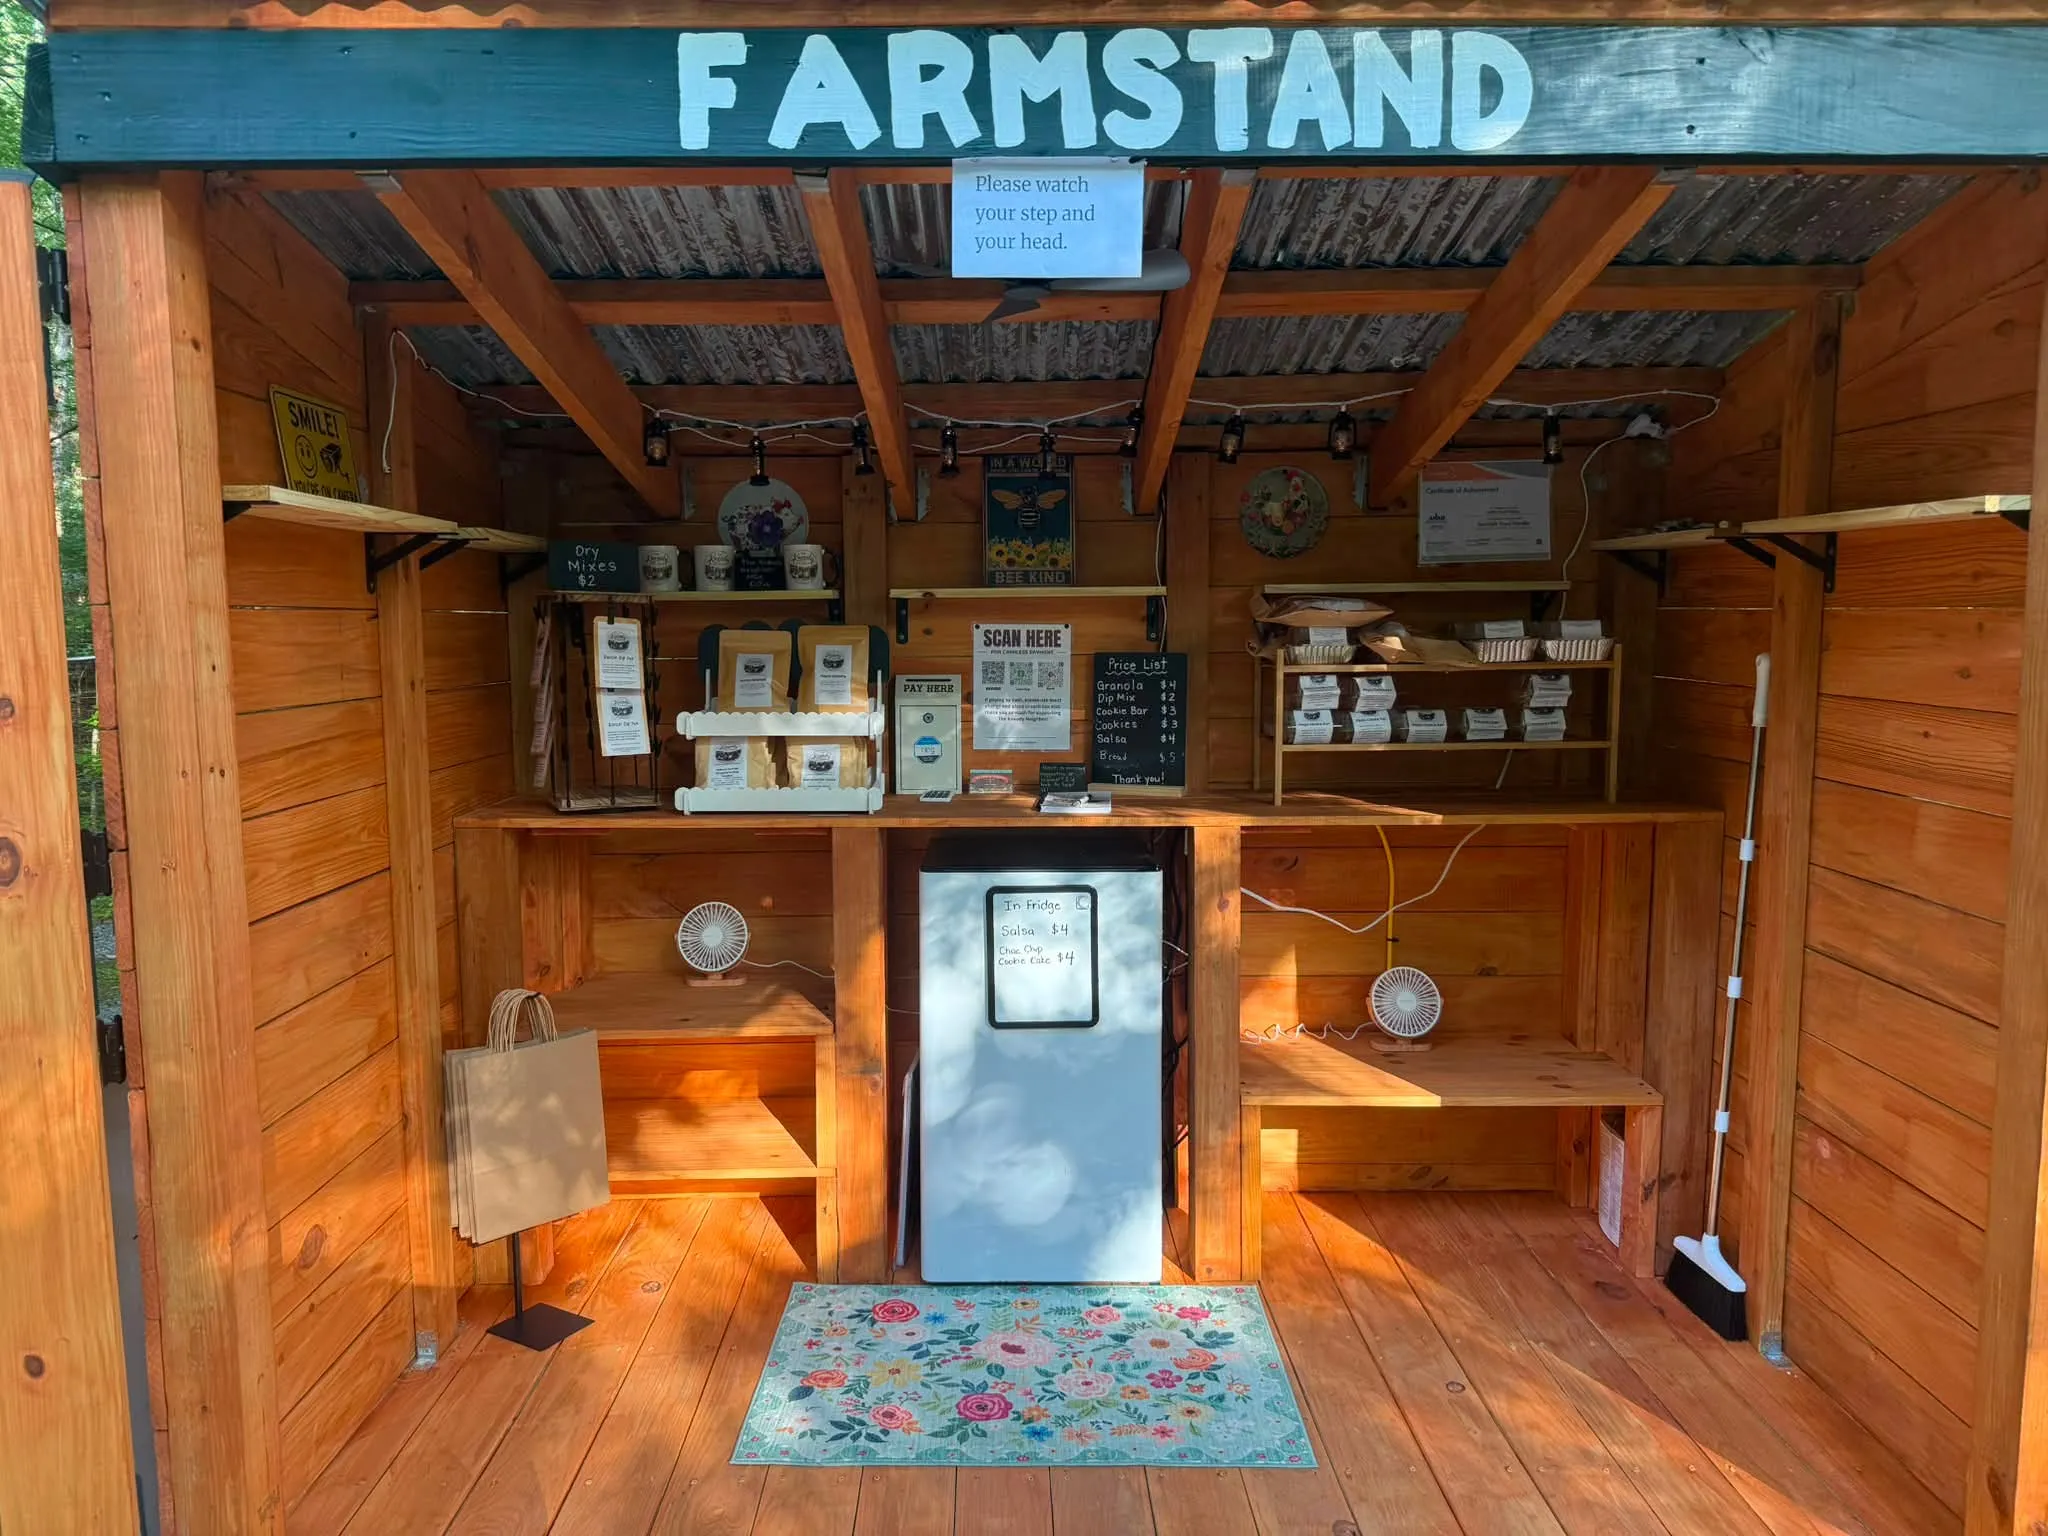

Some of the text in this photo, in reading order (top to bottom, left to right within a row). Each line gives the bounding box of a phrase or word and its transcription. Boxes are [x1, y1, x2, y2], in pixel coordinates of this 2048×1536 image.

[678, 27, 1534, 151] FARMSTAND
[976, 175, 1089, 192] Please watch
[976, 204, 1095, 225] your step and
[976, 232, 1068, 253] your head.
[288, 400, 340, 439] SMILE!
[575, 545, 600, 560] Dry
[568, 560, 617, 573] Mixes
[578, 574, 598, 588] $2
[995, 571, 1066, 584] BEE KIND
[984, 629, 1061, 647] SCAN HERE
[1108, 656, 1168, 671] Price List
[903, 684, 954, 693] PAY HERE
[1097, 679, 1177, 691] Granola $4
[1097, 692, 1176, 706] Dip Mix $2
[1096, 706, 1127, 716] Cookie
[1130, 706, 1149, 716] Bar
[1095, 717, 1138, 731] Cookies
[1096, 733, 1176, 745] Salsa $4
[1099, 750, 1128, 761] Bread
[1112, 770, 1165, 786] Thank you!
[1003, 900, 1021, 912] In
[1026, 899, 1062, 915] Fridge
[1001, 922, 1069, 937] Salsa $4
[998, 951, 1075, 966] Cookie Cake $4
